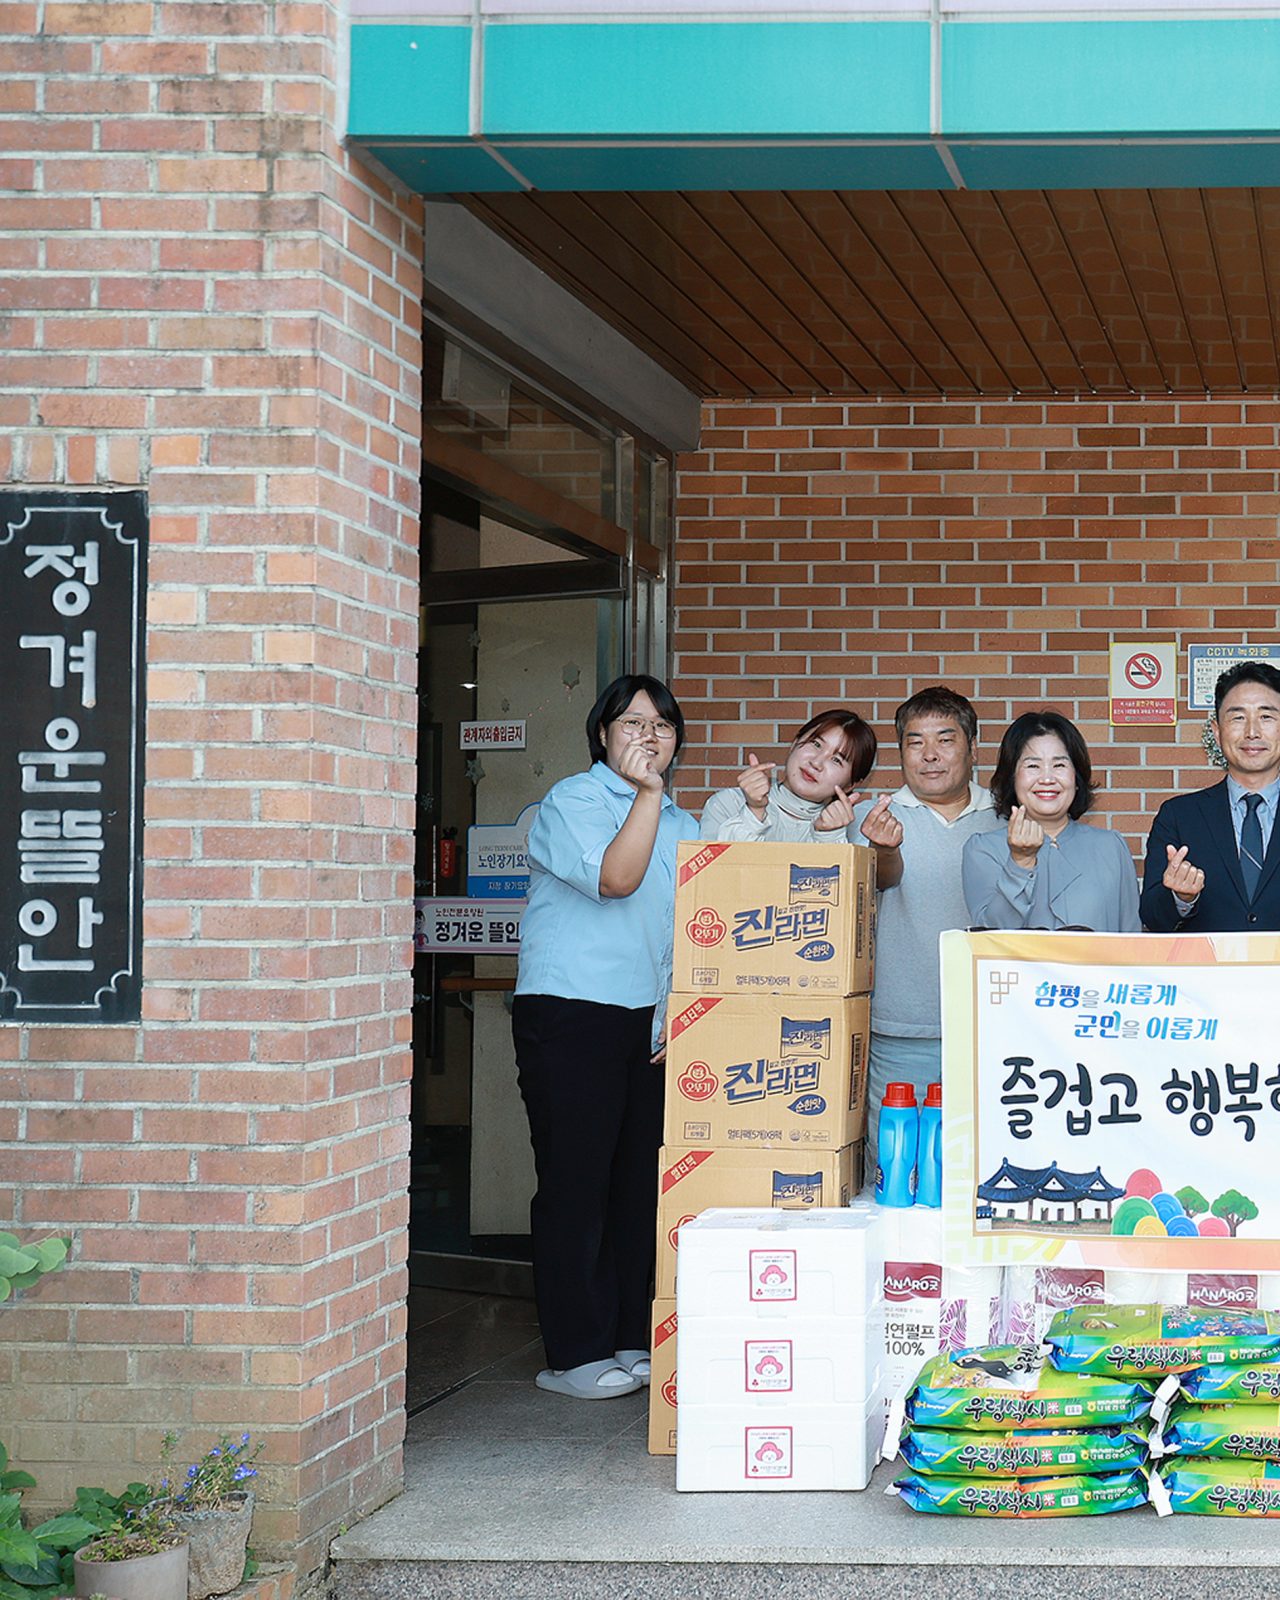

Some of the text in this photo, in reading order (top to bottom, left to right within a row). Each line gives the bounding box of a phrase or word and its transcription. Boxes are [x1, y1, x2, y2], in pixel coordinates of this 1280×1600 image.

[1207, 647, 1235, 656] CCTV
[687, 848, 715, 873] 멀티팩
[435, 921, 484, 943] 정겨운
[694, 928, 719, 940] 오뚜기
[731, 904, 829, 951] 진라면
[1035, 981, 1177, 1009] 함평을 새롭게
[679, 1001, 706, 1027] 멀티팩
[1074, 1010, 1218, 1040] 군민을 이롭게
[685, 1082, 711, 1093] 오뚜기
[723, 1058, 821, 1105] 진라면
[1000, 1056, 1143, 1140] 즐겁고
[670, 1154, 697, 1181] 멀티팩
[885, 1341, 925, 1356] 100%
